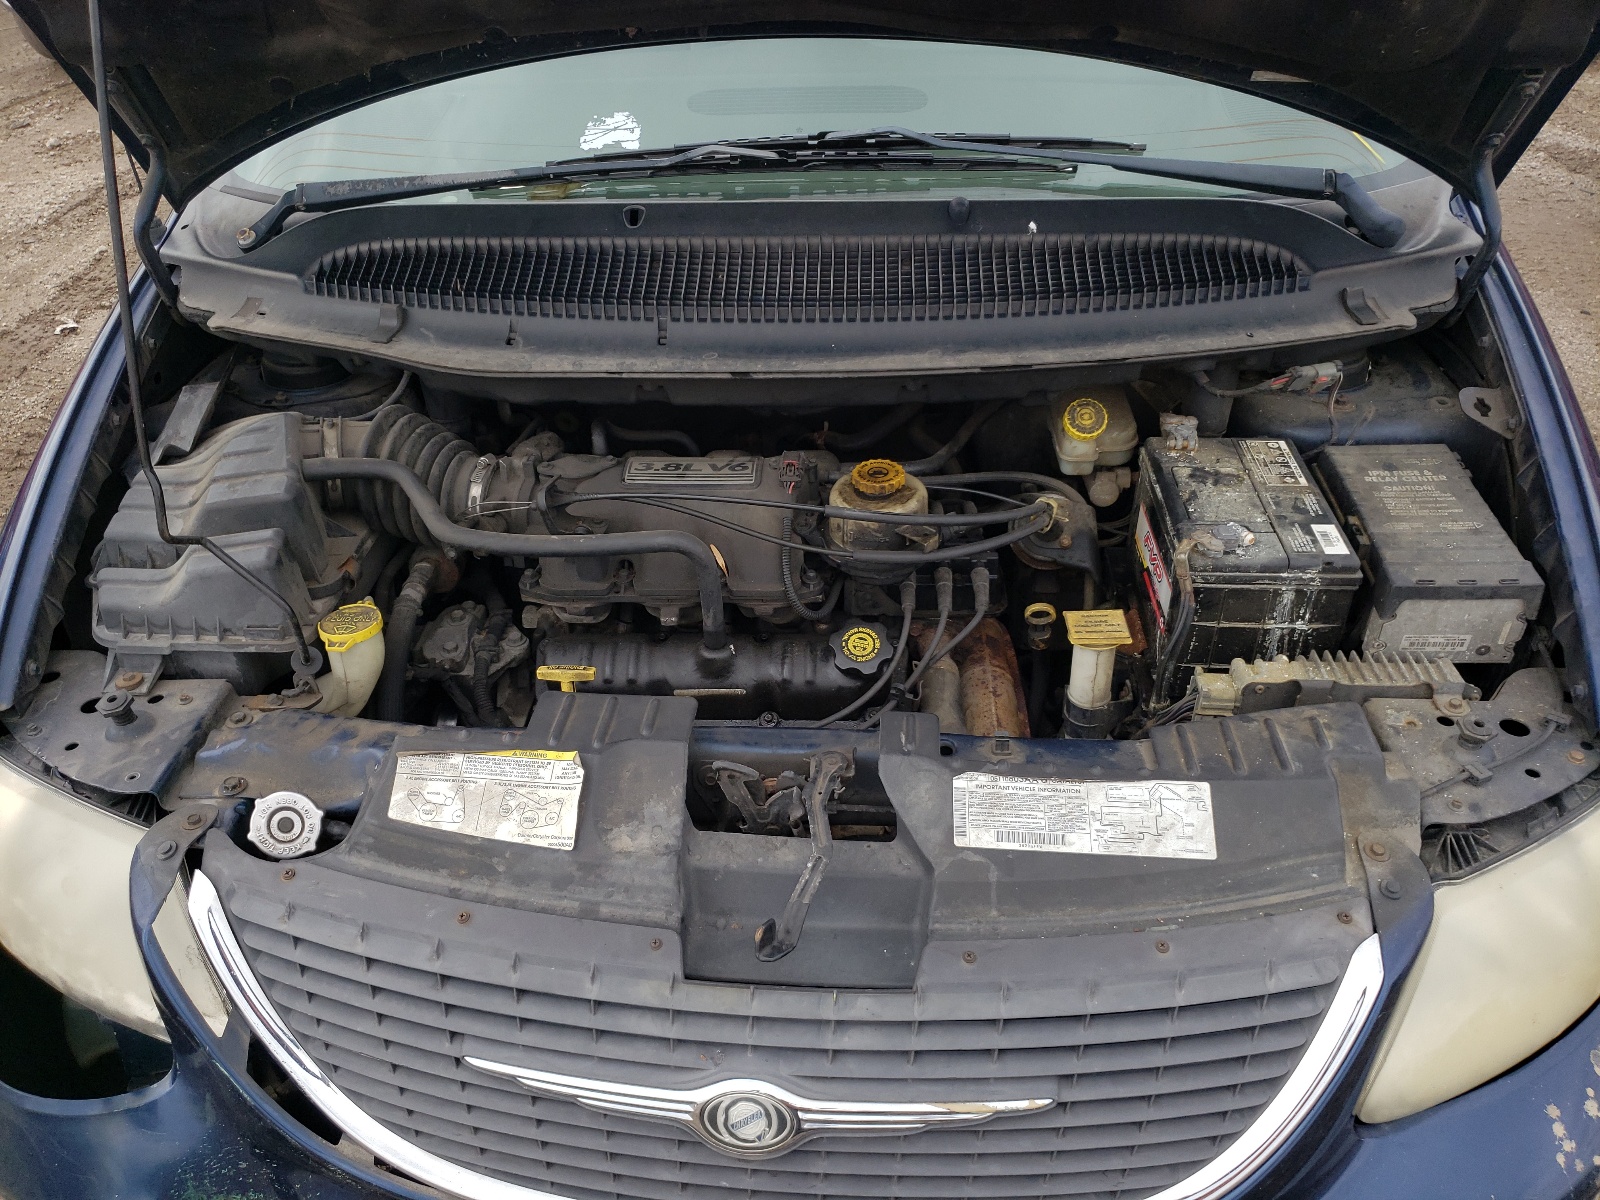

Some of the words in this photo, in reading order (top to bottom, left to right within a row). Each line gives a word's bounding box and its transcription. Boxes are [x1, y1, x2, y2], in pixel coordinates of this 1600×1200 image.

[633, 462, 703, 472] 3.8L
[710, 462, 750, 472] V6
[1143, 531, 1163, 583] FVP
